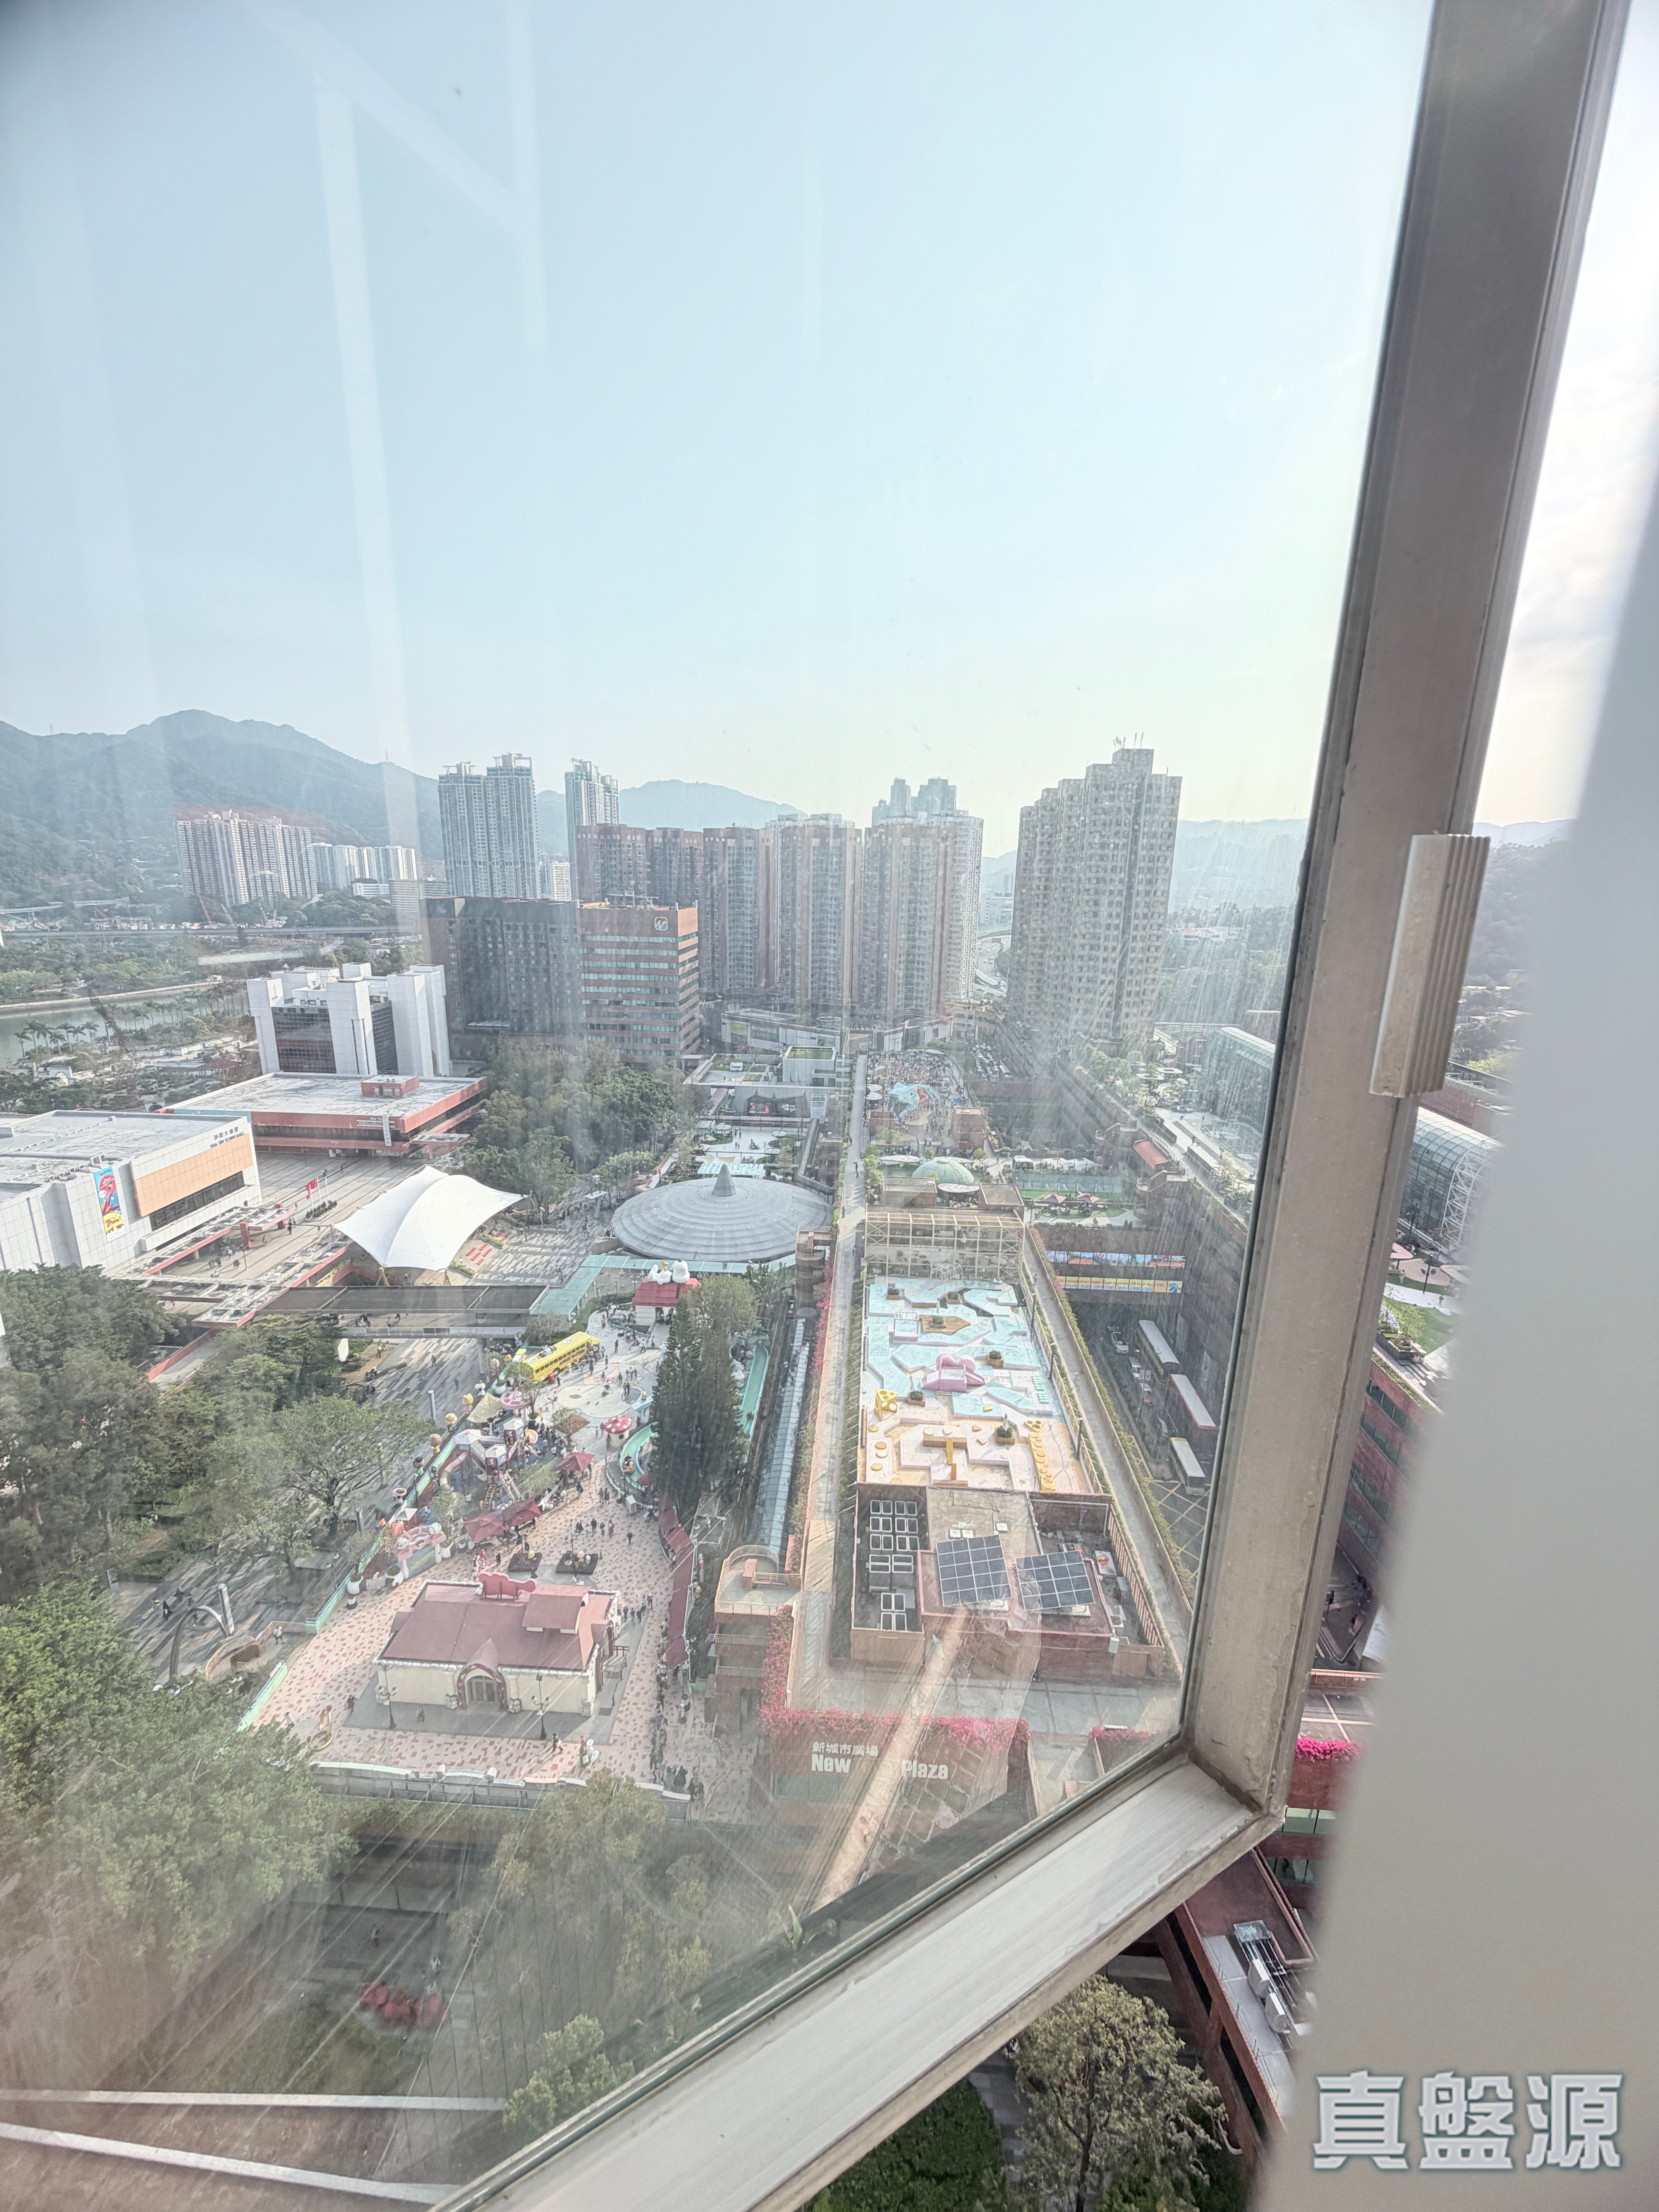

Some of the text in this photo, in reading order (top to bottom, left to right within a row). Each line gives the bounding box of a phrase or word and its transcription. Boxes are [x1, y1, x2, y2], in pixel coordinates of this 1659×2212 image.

[812, 1741, 878, 1757] 新城市廣場
[811, 1753, 948, 1780] New Plaza
